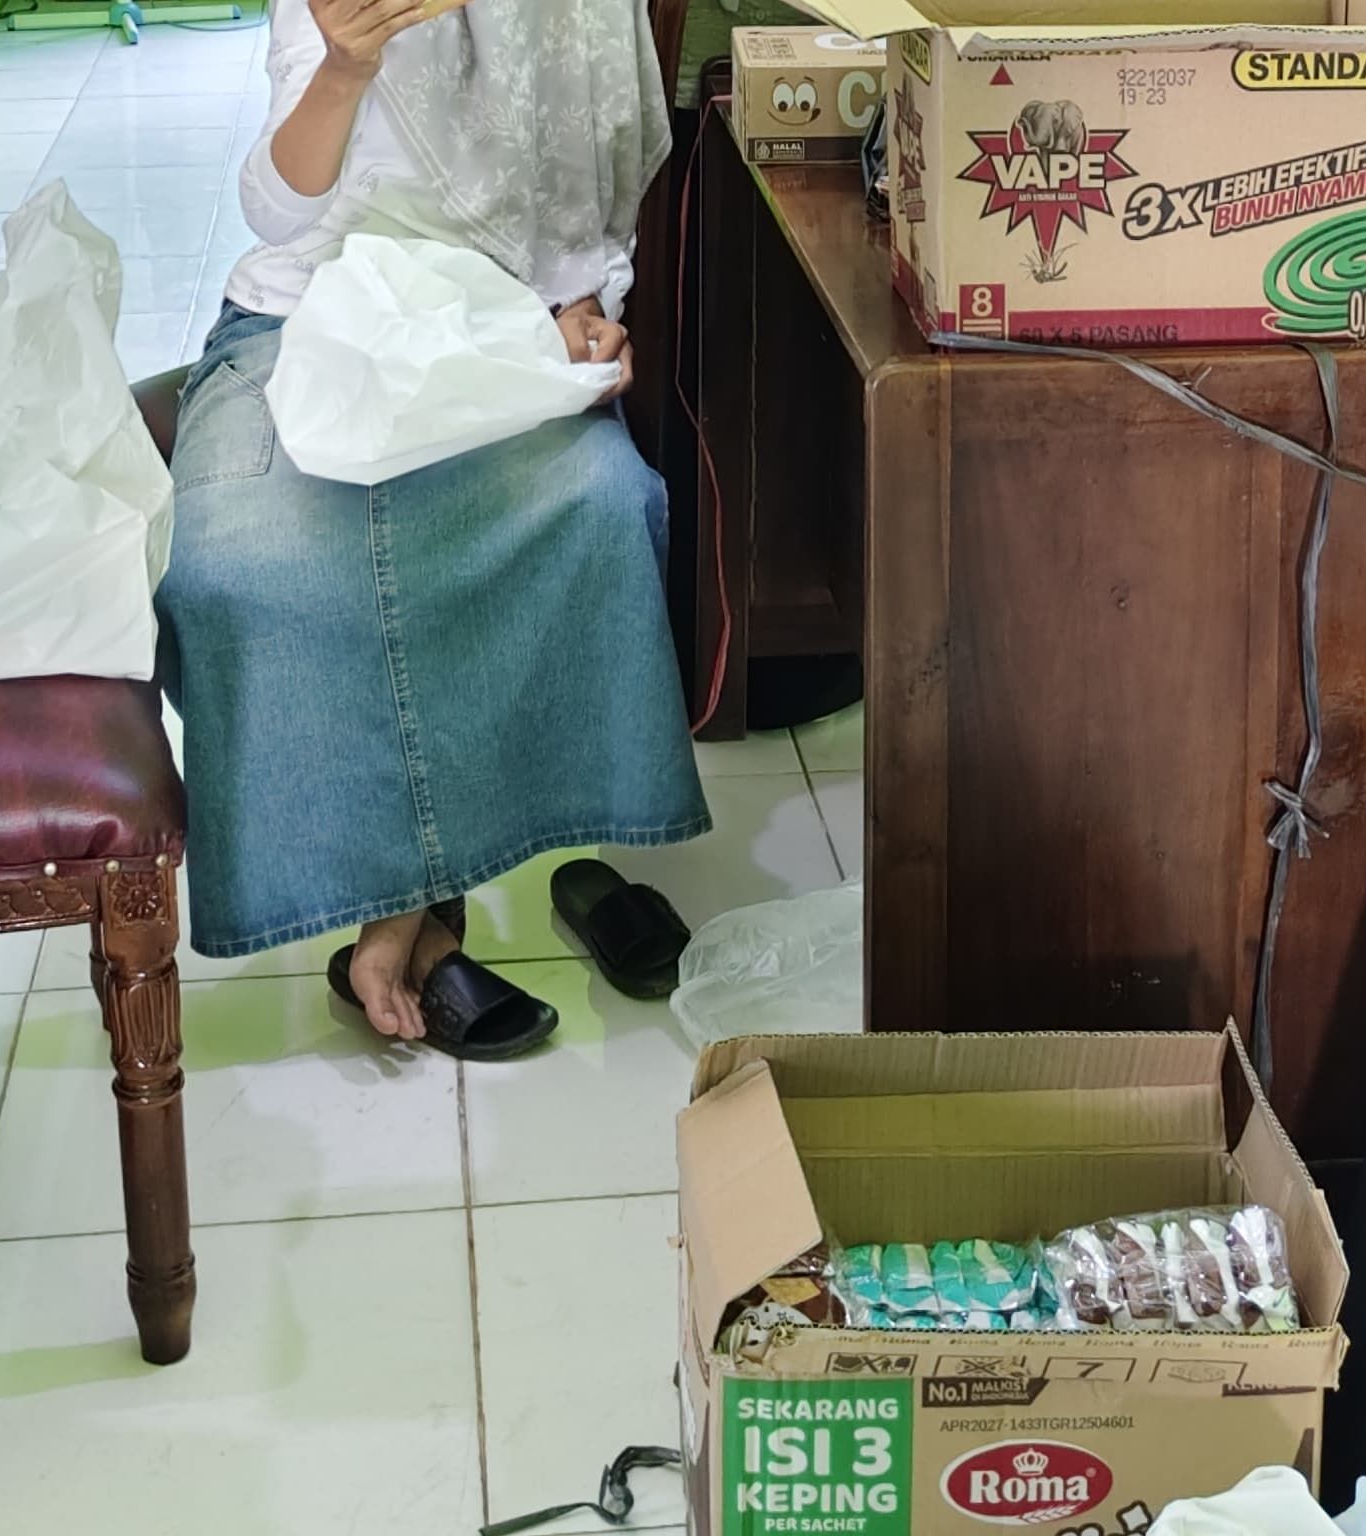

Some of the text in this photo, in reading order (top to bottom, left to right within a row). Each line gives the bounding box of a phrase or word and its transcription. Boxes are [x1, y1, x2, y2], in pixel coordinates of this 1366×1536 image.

[1116, 68, 1197, 87] 92212037
[990, 153, 1106, 189] VAPE
[1204, 166, 1272, 207] LEBIH
[1213, 190, 1299, 232] BUNUH
[971, 286, 993, 317] 8
[1090, 325, 1179, 344] PASANG
[928, 1378, 1030, 1402] No.1 MALKIST
[738, 1398, 899, 1420] SEKARANG
[744, 1426, 892, 1476] ISI 3
[736, 1483, 899, 1513] KEPING
[969, 1469, 1090, 1504] Roma
[765, 1518, 866, 1531] PER SACHET
